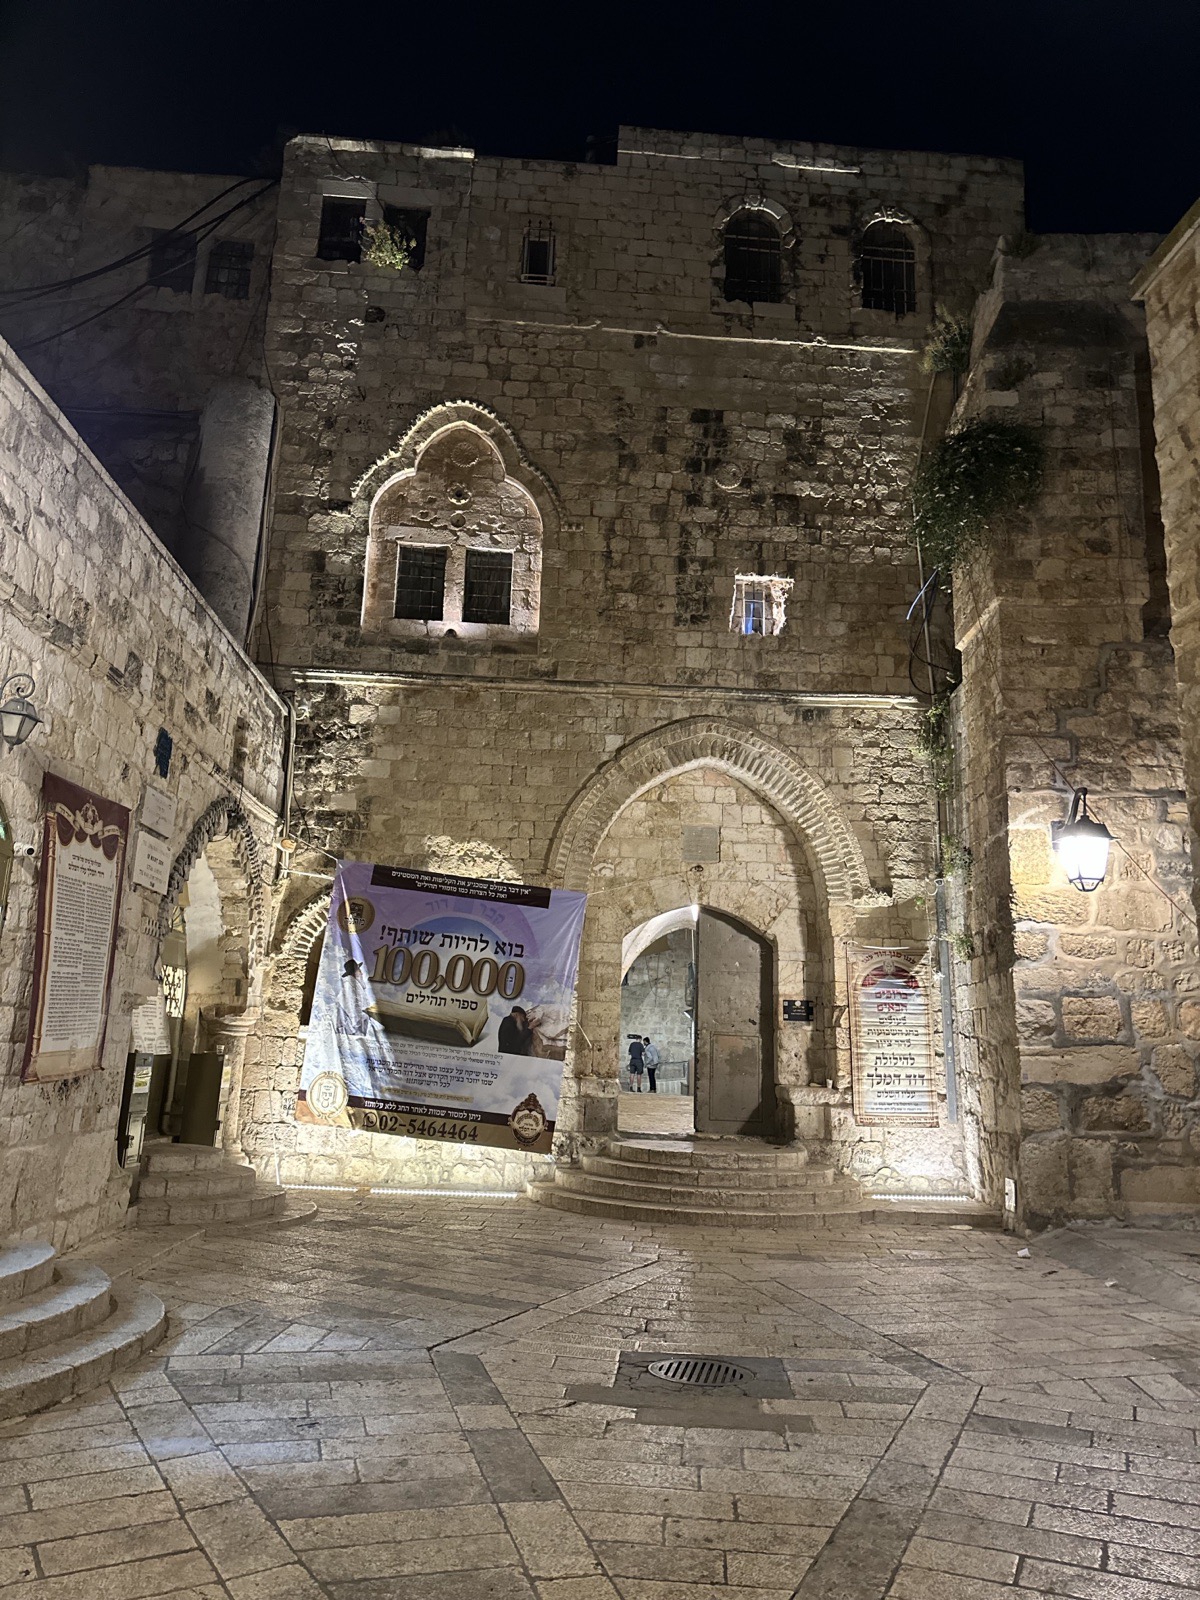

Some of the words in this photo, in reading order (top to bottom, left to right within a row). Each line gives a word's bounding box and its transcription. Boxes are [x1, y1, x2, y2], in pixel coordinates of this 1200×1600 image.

[432, 876, 456, 885] הקליפות
[439, 884, 457, 892] מזמורי
[489, 884, 507, 892] בעולם
[379, 925, 435, 947] שותף!
[439, 933, 490, 952] להיות
[493, 940, 525, 957] בוא
[368, 944, 525, 1000] 100,000
[406, 991, 447, 1007] תהילים
[450, 998, 478, 1011] ספרי
[874, 1052, 915, 1065] להילולת
[404, 1061, 424, 1070] תהילים
[439, 1066, 454, 1074] עצמו
[455, 1066, 463, 1075] על
[465, 1069, 481, 1077] שיקח
[490, 1071, 498, 1079] כל
[428, 1073, 448, 1081] הקדוש
[867, 1067, 901, 1088] המלך
[905, 1073, 925, 1085] דוד
[384, 1102, 396, 1110] ללא
[411, 1105, 427, 1114] לאחר
[428, 1108, 446, 1116] שמות
[448, 1110, 467, 1119] למסור
[468, 1113, 481, 1121] ניתן
[380, 1115, 478, 1141] 02-5464464
